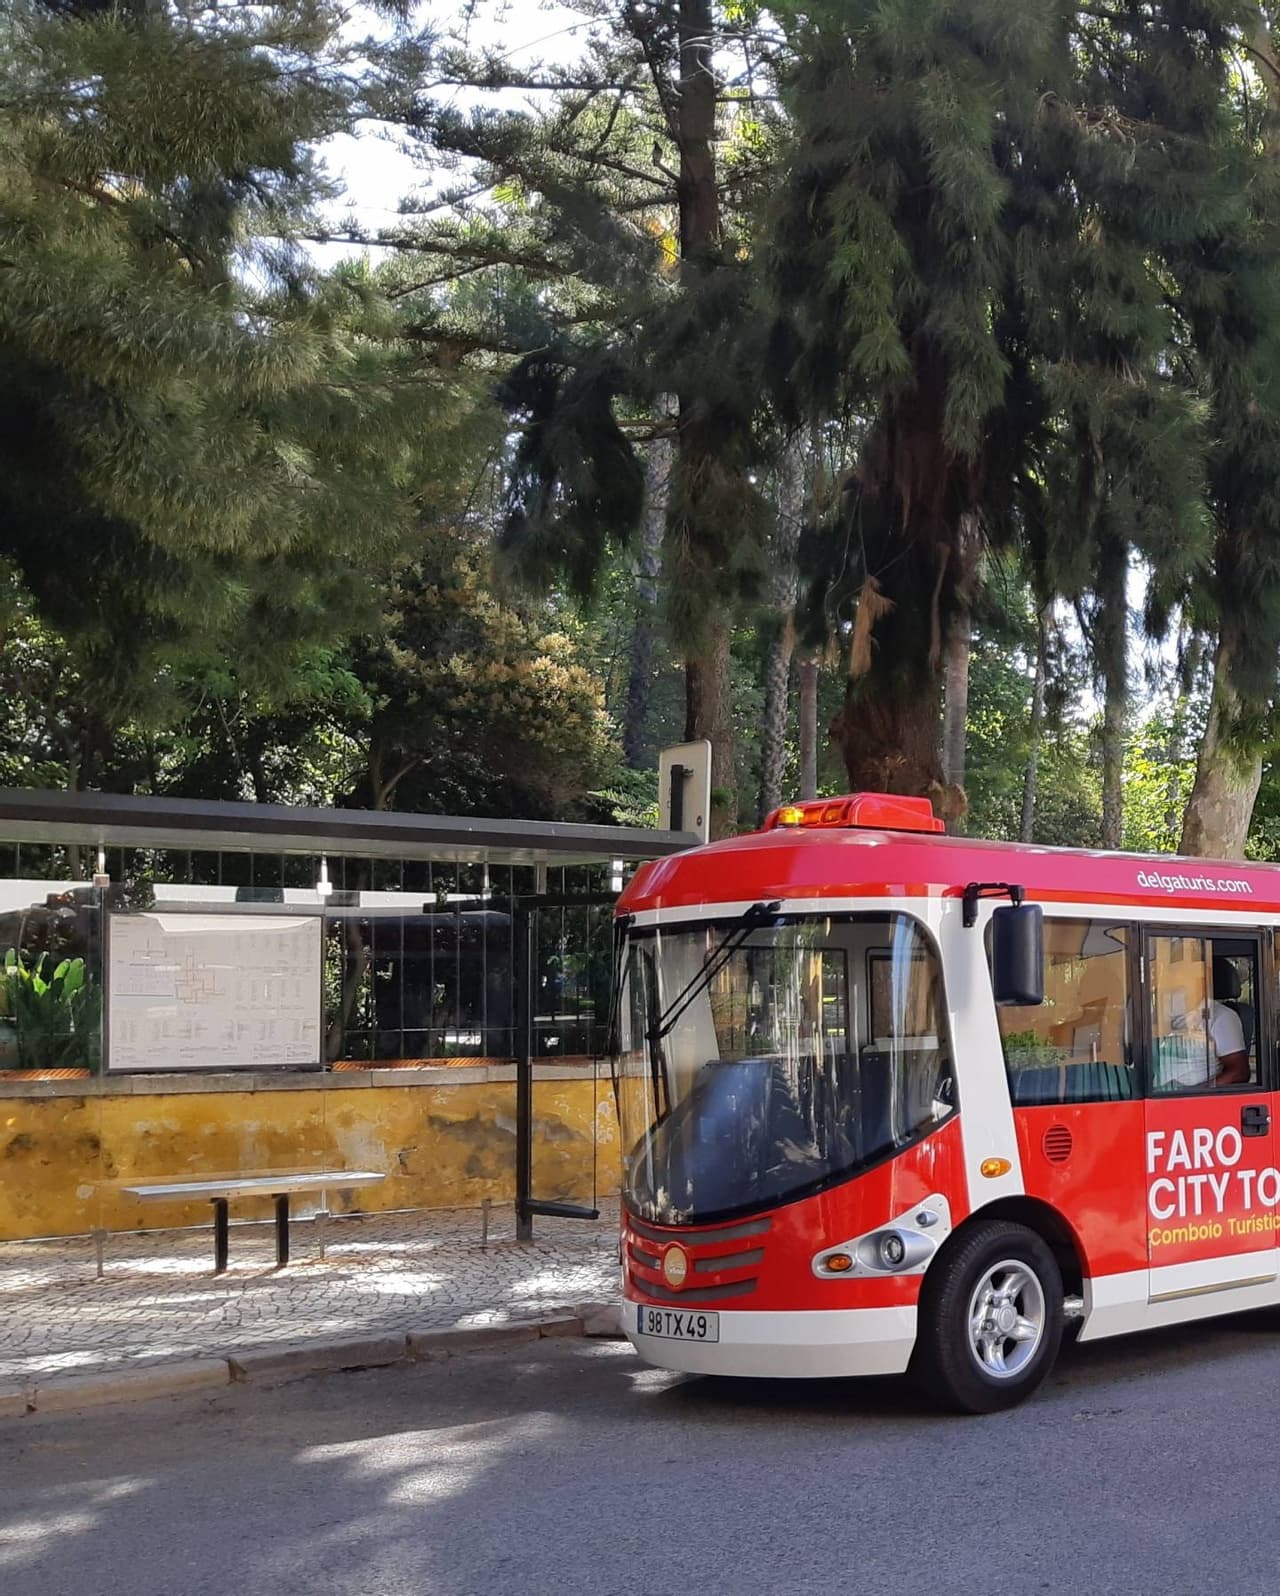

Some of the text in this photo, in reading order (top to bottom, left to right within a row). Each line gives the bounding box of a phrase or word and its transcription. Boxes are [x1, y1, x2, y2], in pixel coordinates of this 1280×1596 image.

[1137, 870, 1253, 893] delgaturis.com
[1147, 1126, 1242, 1173] FARO
[1148, 1172, 1230, 1219] CITY
[1150, 1220, 1222, 1246] Comboio
